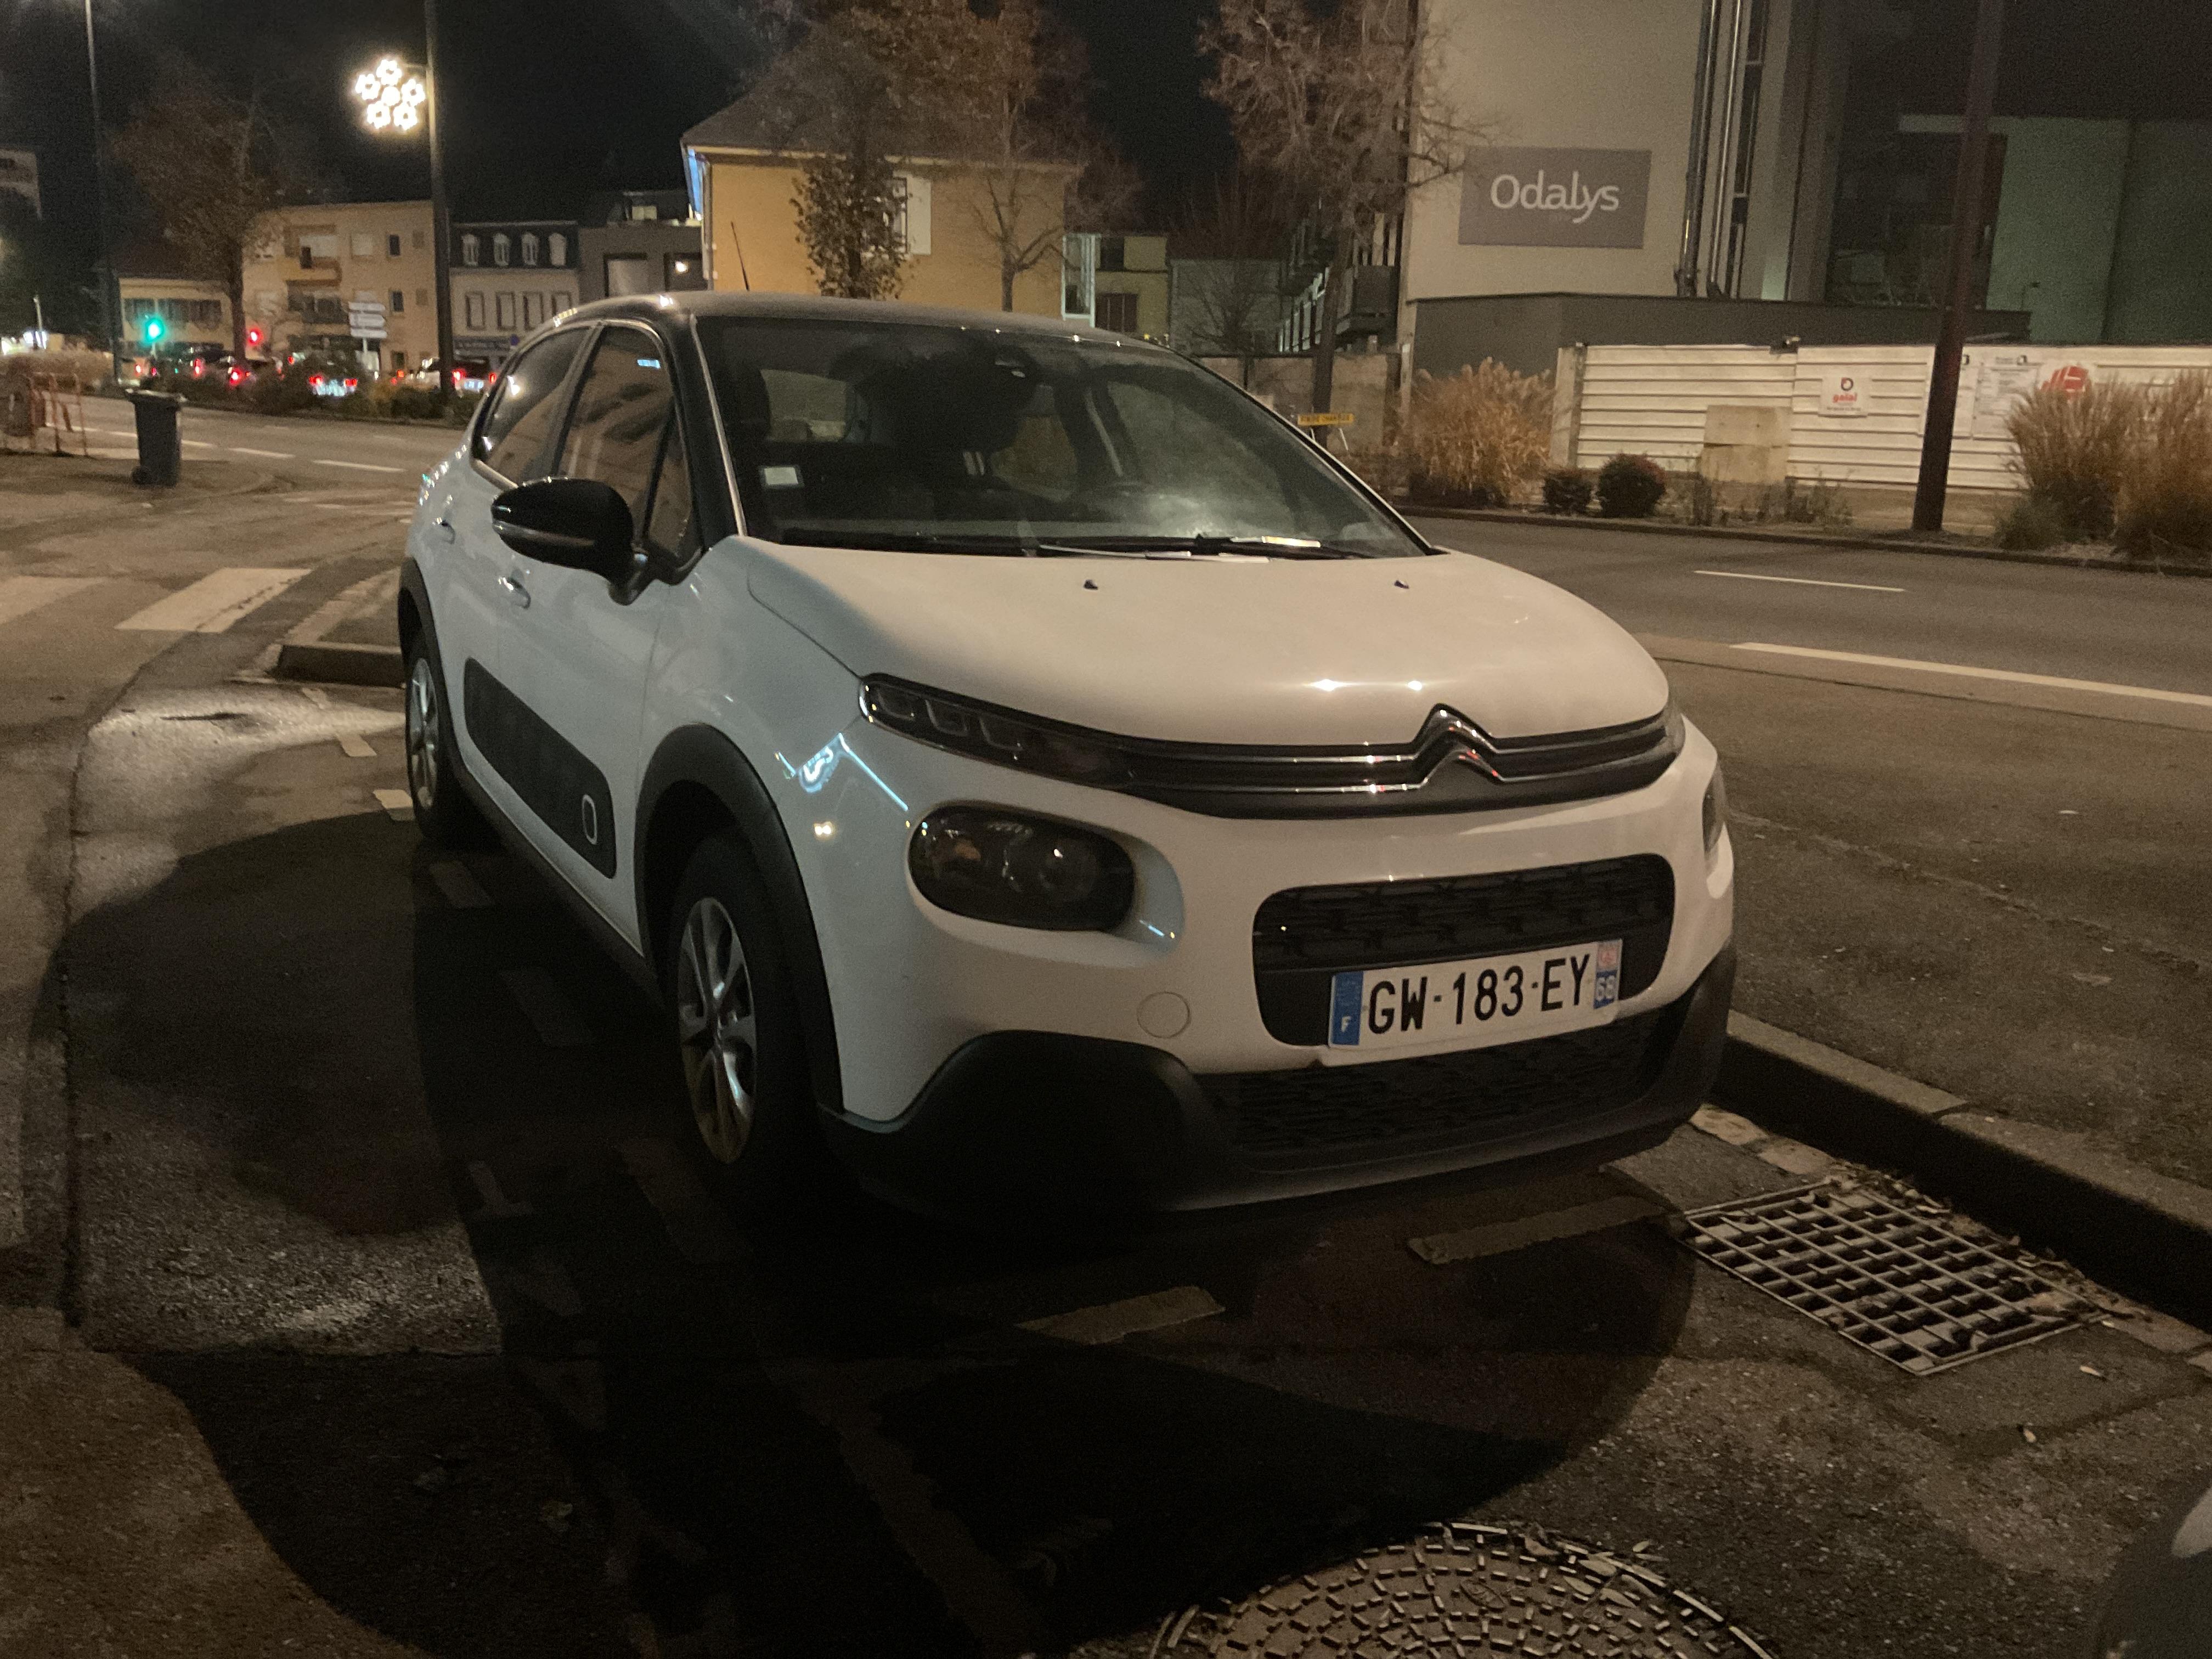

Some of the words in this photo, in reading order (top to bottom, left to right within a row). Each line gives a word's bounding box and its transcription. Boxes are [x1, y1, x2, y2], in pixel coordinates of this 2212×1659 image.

[1491, 169, 1619, 223] Odalys
[1368, 953, 1590, 1034] GW-183-EY
[1595, 975, 1615, 1001] 68
[1341, 1015, 1352, 1032] F
